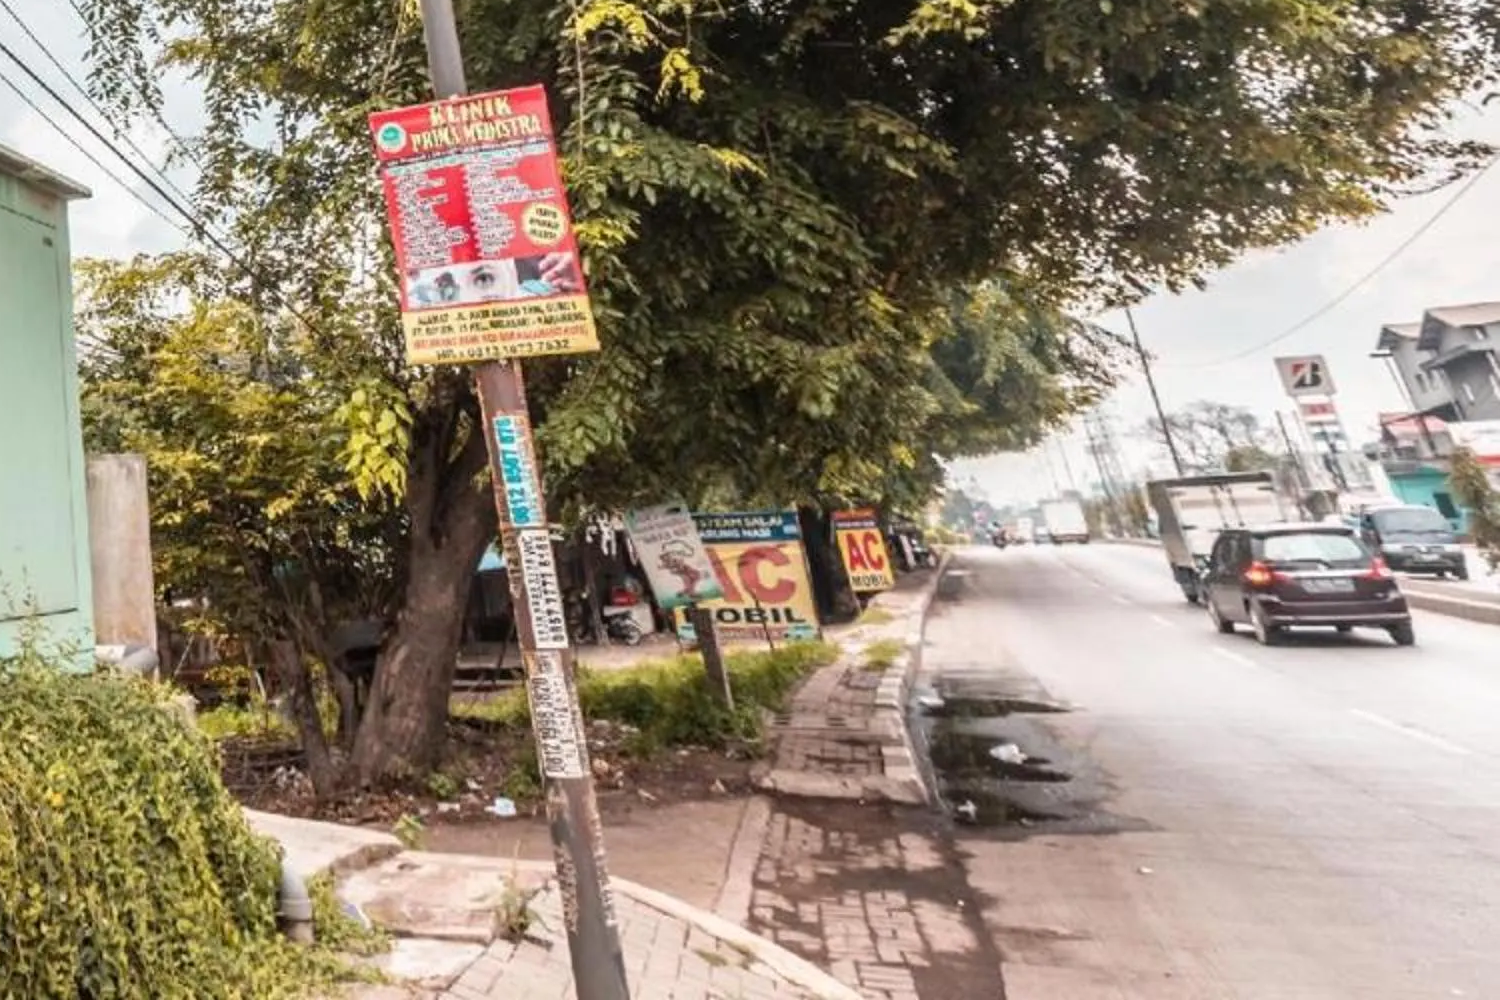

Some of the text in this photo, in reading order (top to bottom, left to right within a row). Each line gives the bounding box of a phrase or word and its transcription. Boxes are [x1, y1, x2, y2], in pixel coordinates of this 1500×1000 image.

[429, 97, 512, 125] KLINIK
[845, 531, 884, 571] AC
[851, 574, 891, 587] MOBIL
[685, 608, 806, 623] OBIL
